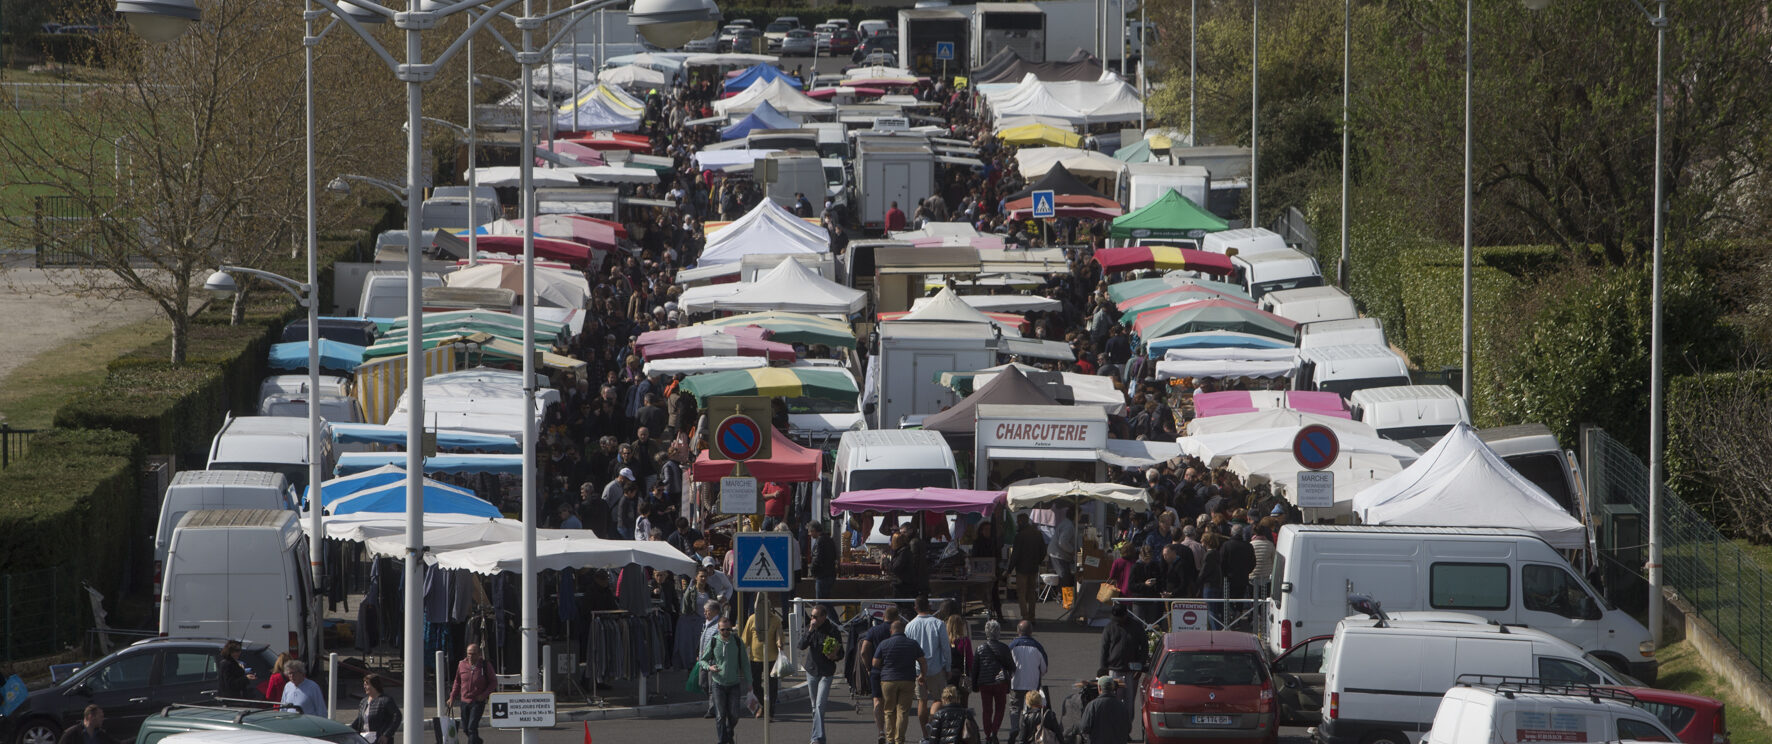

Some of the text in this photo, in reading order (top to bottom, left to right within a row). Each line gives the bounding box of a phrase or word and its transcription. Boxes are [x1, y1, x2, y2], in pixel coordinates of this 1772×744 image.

[996, 423, 1088, 441] CHARCUTERIE
[1301, 474, 1329, 482] MARCHE
[725, 480, 753, 488] MARCHE
